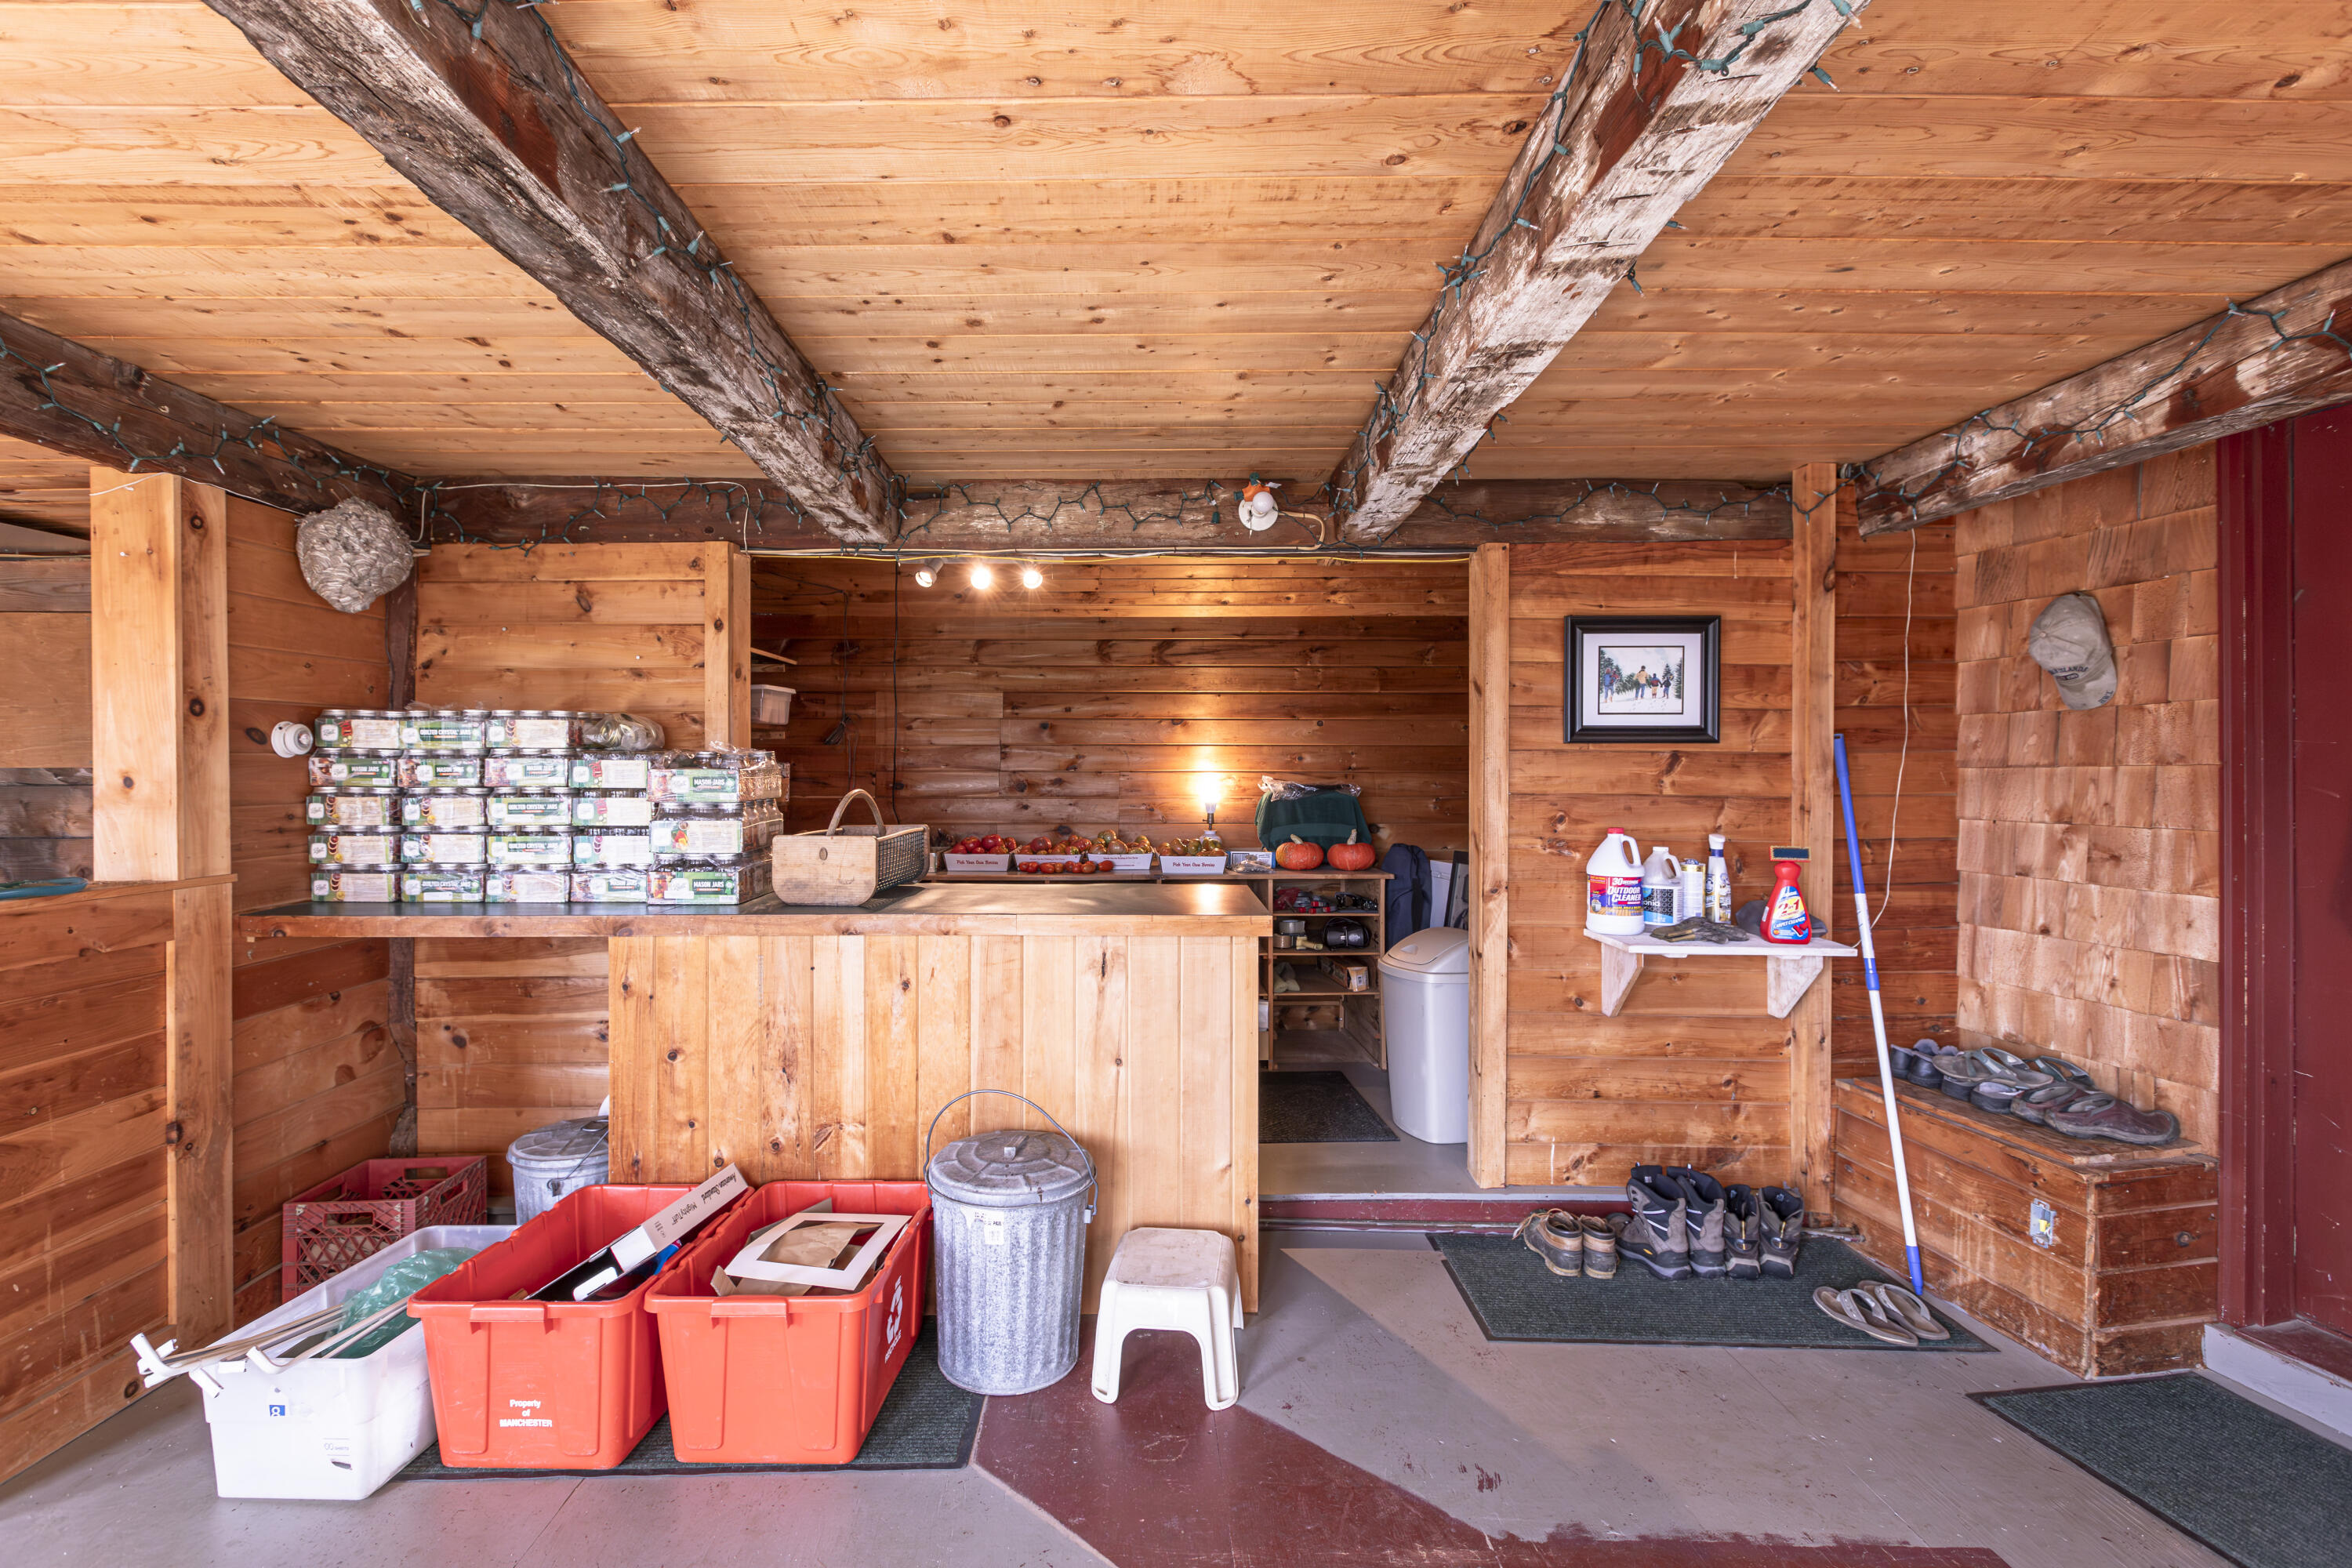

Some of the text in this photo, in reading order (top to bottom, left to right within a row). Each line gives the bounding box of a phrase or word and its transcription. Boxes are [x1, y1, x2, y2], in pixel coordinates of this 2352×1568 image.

[1607, 886, 1641, 895] OUTDOOR
[1612, 894, 1642, 902] CLEANER
[701, 1172, 737, 1204] American Standard
[884, 1329, 902, 1364] RECYCLE
[510, 1399, 541, 1409] Property
[499, 1419, 553, 1428] MANCHESTER
